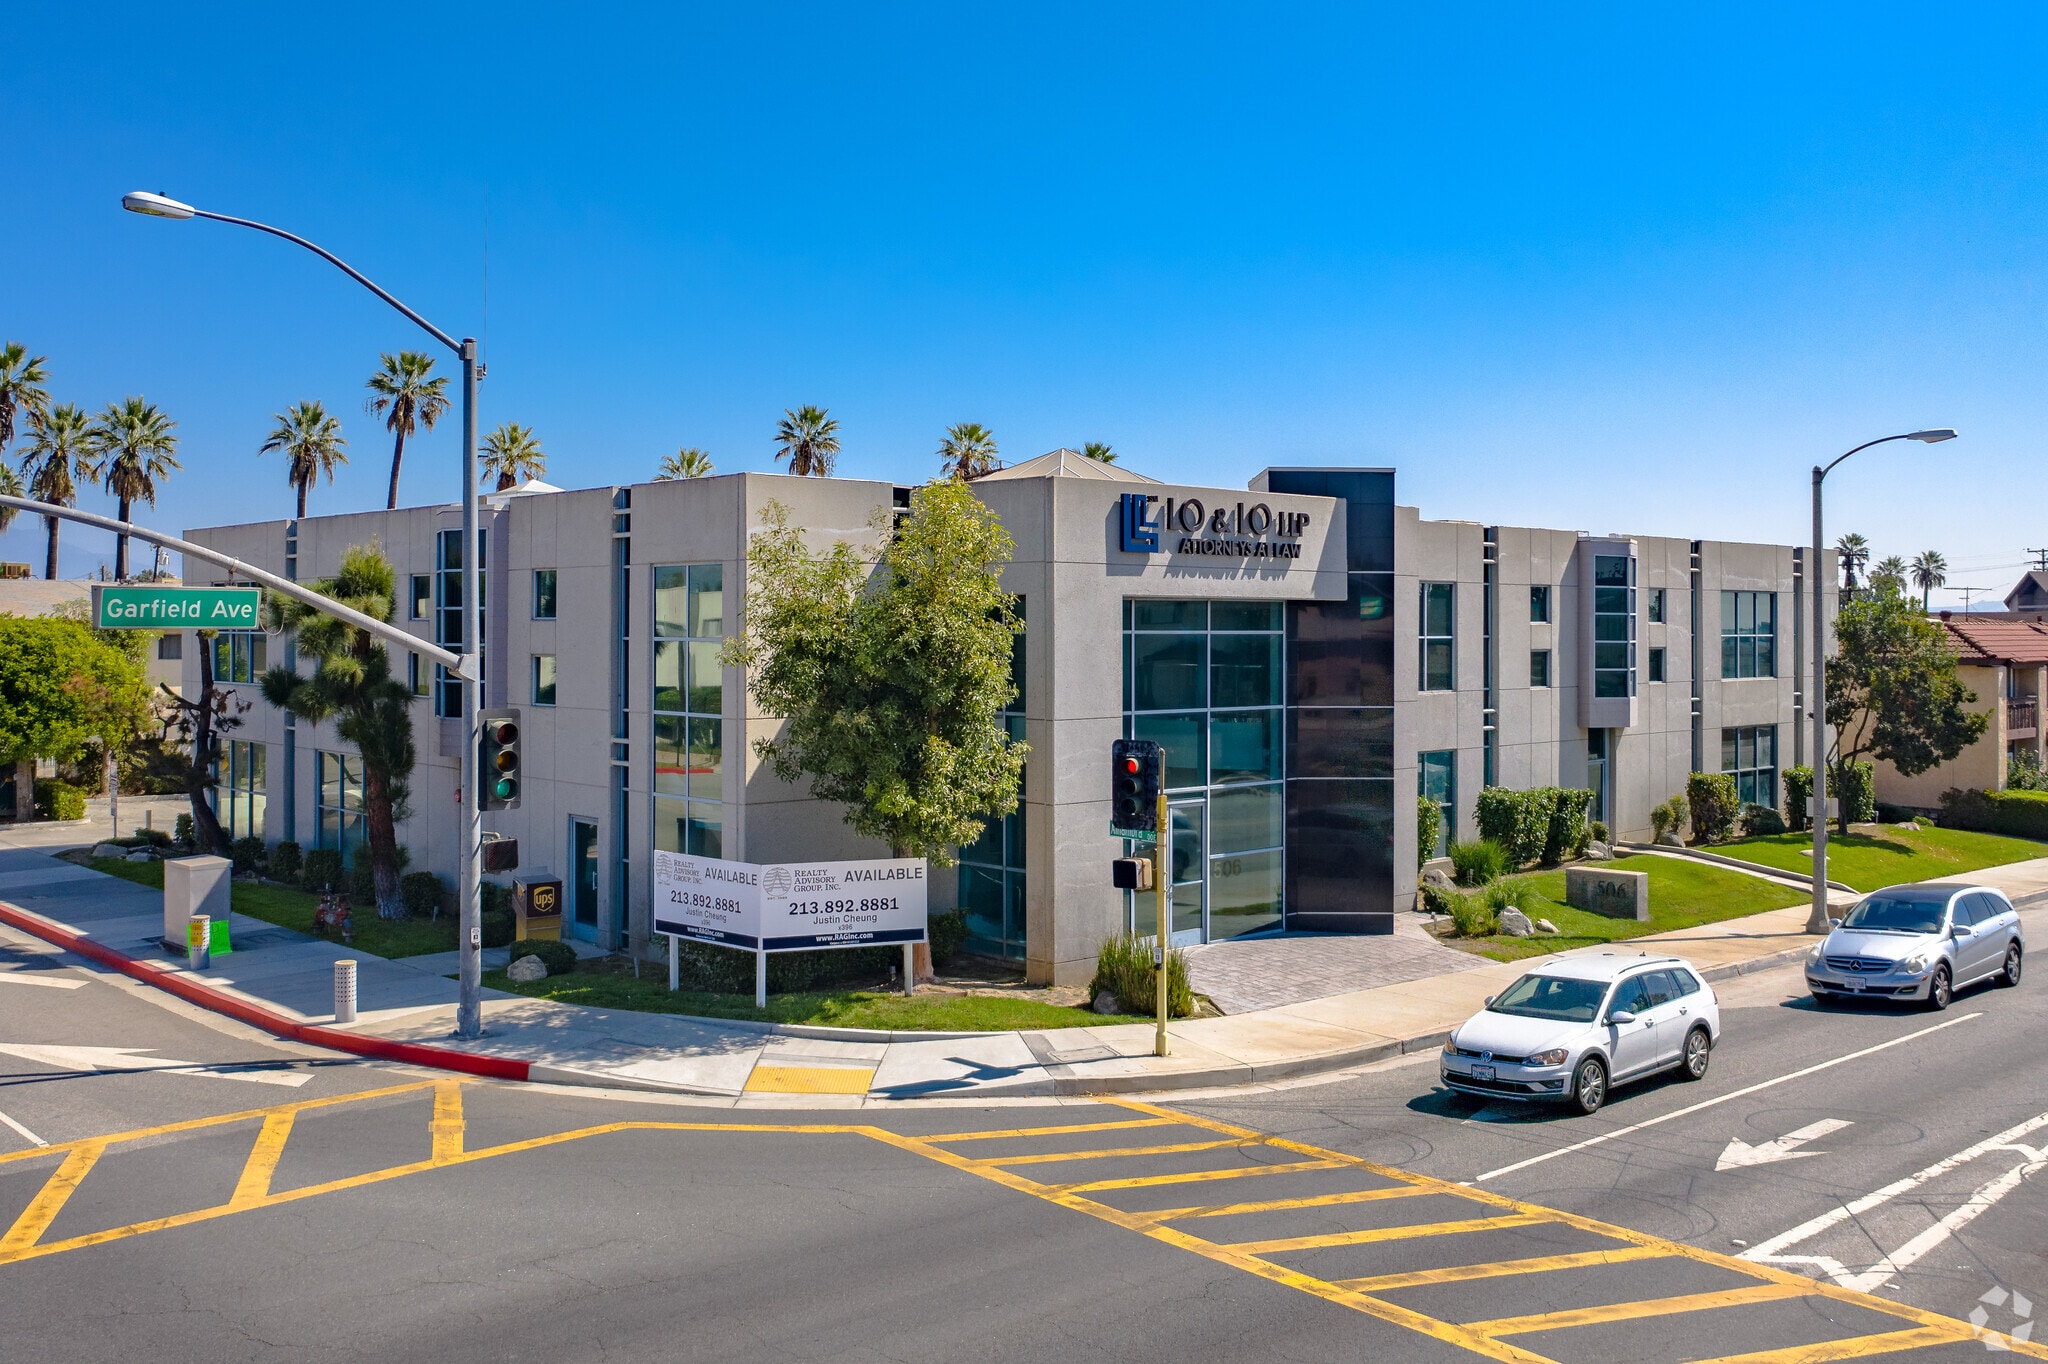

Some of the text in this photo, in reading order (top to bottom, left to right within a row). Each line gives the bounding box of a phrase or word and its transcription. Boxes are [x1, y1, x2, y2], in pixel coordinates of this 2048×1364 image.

[1166, 497, 1311, 537] LO & LO LLP
[1178, 538, 1302, 559] ATTORNEYS AT LAW
[107, 598, 253, 618] Garfield Ave
[673, 859, 695, 869] REALTY
[673, 867, 700, 877] ADVISORY
[1213, 859, 1241, 878] 506
[704, 867, 757, 886] AVAILABLE
[794, 869, 828, 877] REALTY
[794, 876, 836, 885] ADVISORY
[844, 867, 923, 883] AVAILABLE
[825, 883, 841, 891] INC.
[1598, 880, 1626, 897] 506
[535, 894, 553, 908] ups
[671, 890, 741, 913] 213.892.8881
[789, 897, 899, 915] 213.892.8881
[686, 907, 726, 924] Justin Cheung
[813, 914, 878, 925] Justin Cheung
[816, 932, 873, 942] www.RAGinc.com
